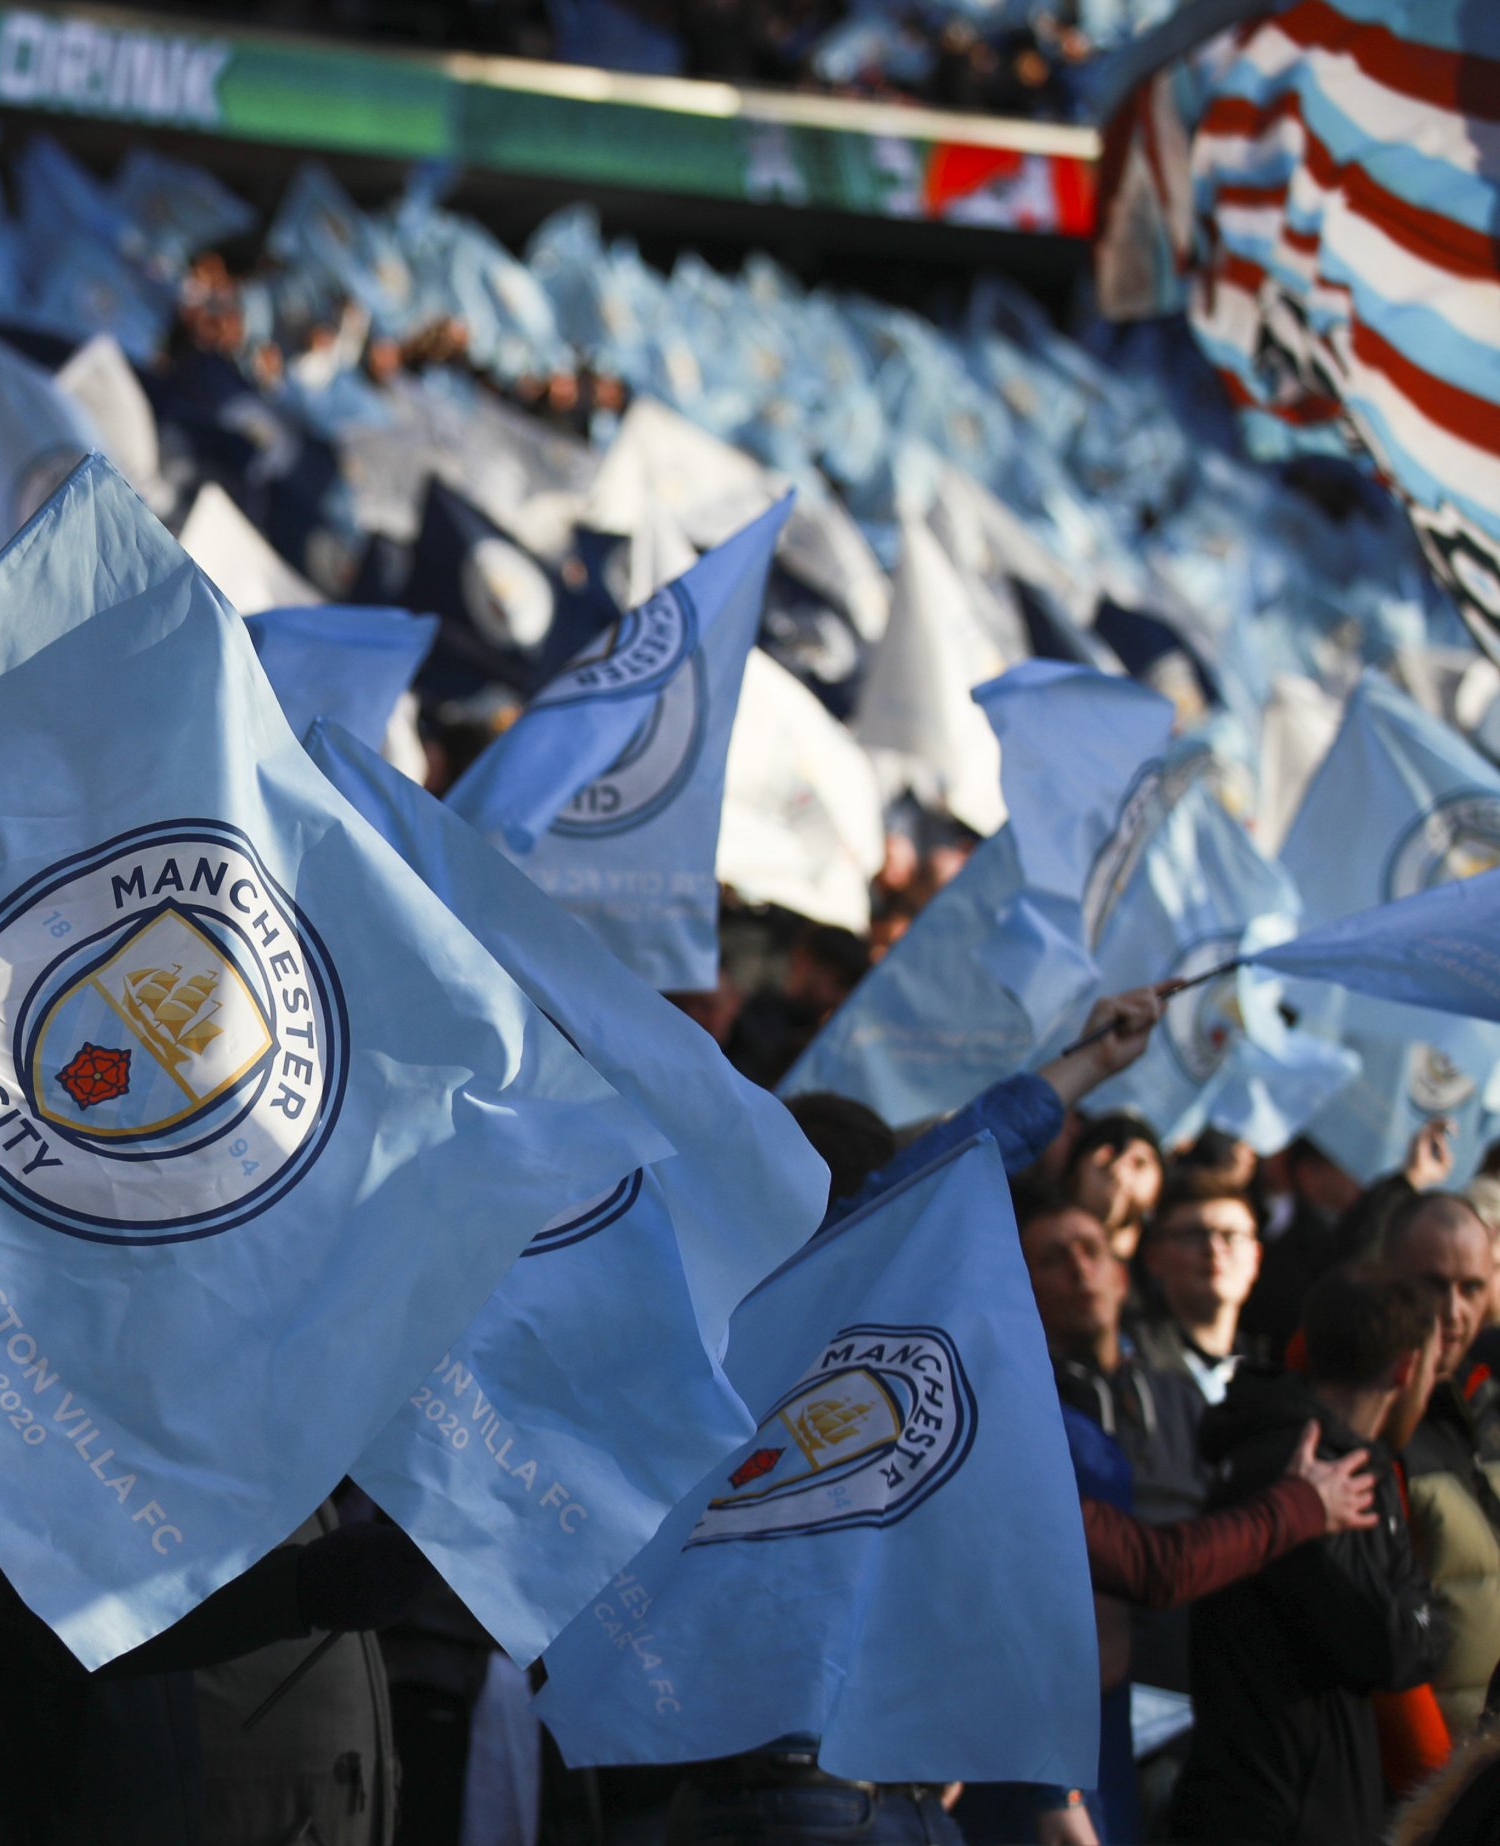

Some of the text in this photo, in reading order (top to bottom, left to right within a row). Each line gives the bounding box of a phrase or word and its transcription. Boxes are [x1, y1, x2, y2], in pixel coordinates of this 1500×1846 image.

[40, 910, 73, 938] 18
[110, 857, 314, 1120] MANCHESTER
[227, 1137, 260, 1177] 94
[410, 1386, 469, 1450] 2020
[471, 1388, 538, 1491] VILLA
[539, 1481, 588, 1534] FC
[52, 1392, 138, 1504] VILLA
[131, 1500, 183, 1554] FC
